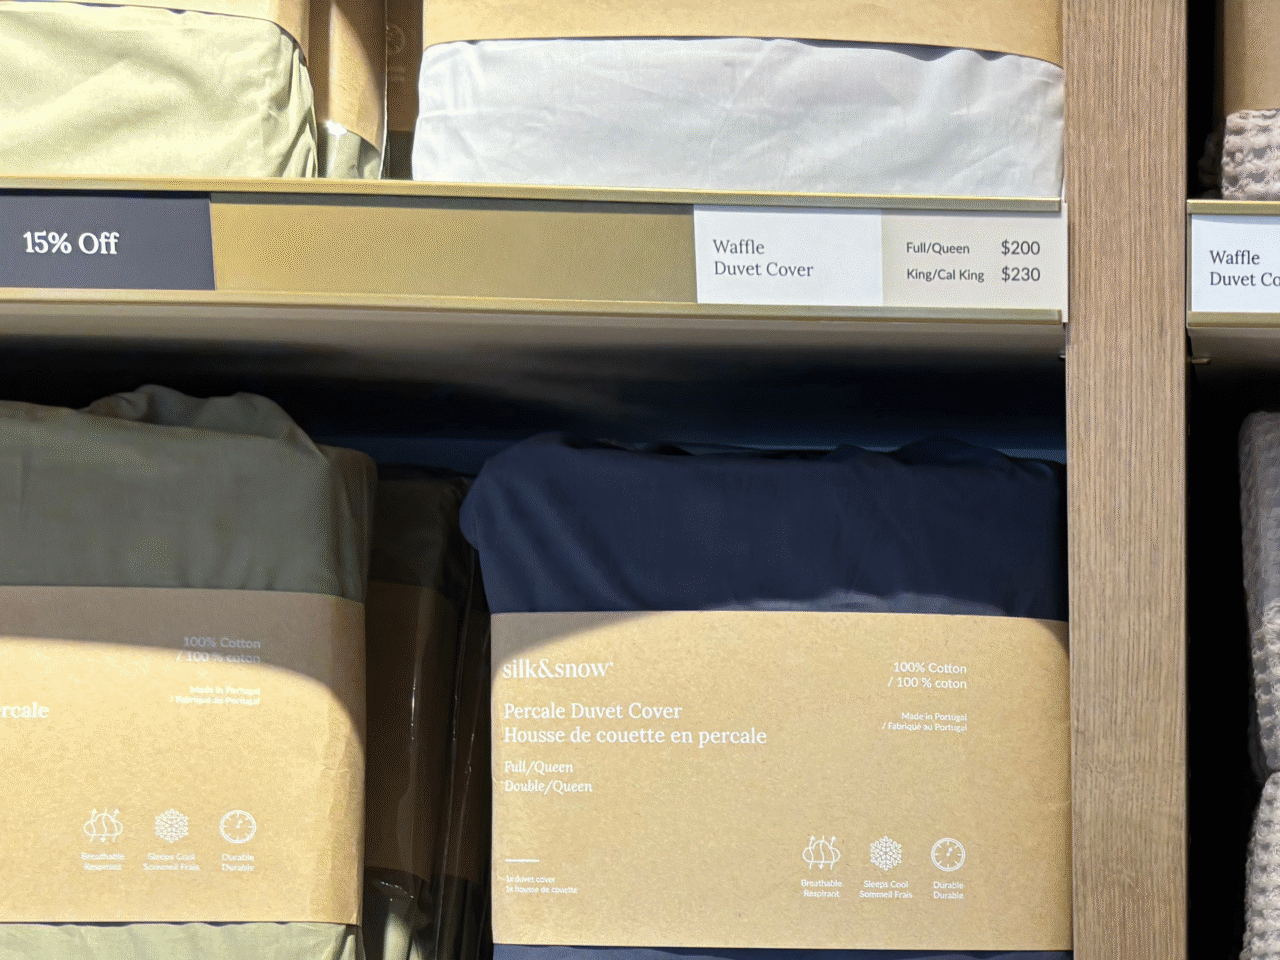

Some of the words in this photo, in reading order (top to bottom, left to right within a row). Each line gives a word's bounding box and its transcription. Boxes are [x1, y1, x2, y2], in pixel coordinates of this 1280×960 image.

[23, 231, 72, 255] 15%
[78, 231, 119, 256] Off
[713, 238, 765, 256] Waffle
[906, 241, 970, 256] Full/Queen
[1000, 239, 1041, 257] $200
[1209, 249, 1261, 266] Waffle
[714, 261, 761, 276] Duvet
[766, 261, 814, 277] Cover
[906, 267, 956, 283] King/Cal
[960, 268, 984, 284] King
[1000, 266, 1041, 283] $230
[1209, 271, 1256, 287] Duvet
[187, 651, 209, 662] 100
[893, 661, 926, 673] 100%
[928, 662, 967, 674] Cotton
[897, 676, 919, 688] 100
[935, 679, 967, 689] coton
[504, 702, 566, 719] Percale
[570, 702, 623, 719] Duvet
[628, 702, 682, 719] Cover
[901, 712, 924, 720] Made
[925, 712, 933, 720] in
[934, 712, 967, 723] Portugal
[934, 723, 967, 733] Portugal
[504, 726, 565, 743] Housse
[570, 726, 591, 743] de
[596, 727, 666, 744] couette
[671, 729, 693, 743] en
[699, 727, 767, 748] percale
[504, 760, 574, 775] Full/Queen
[504, 779, 593, 795] Double/Queen
[933, 881, 964, 890] Durable
[933, 891, 964, 900] Durable
